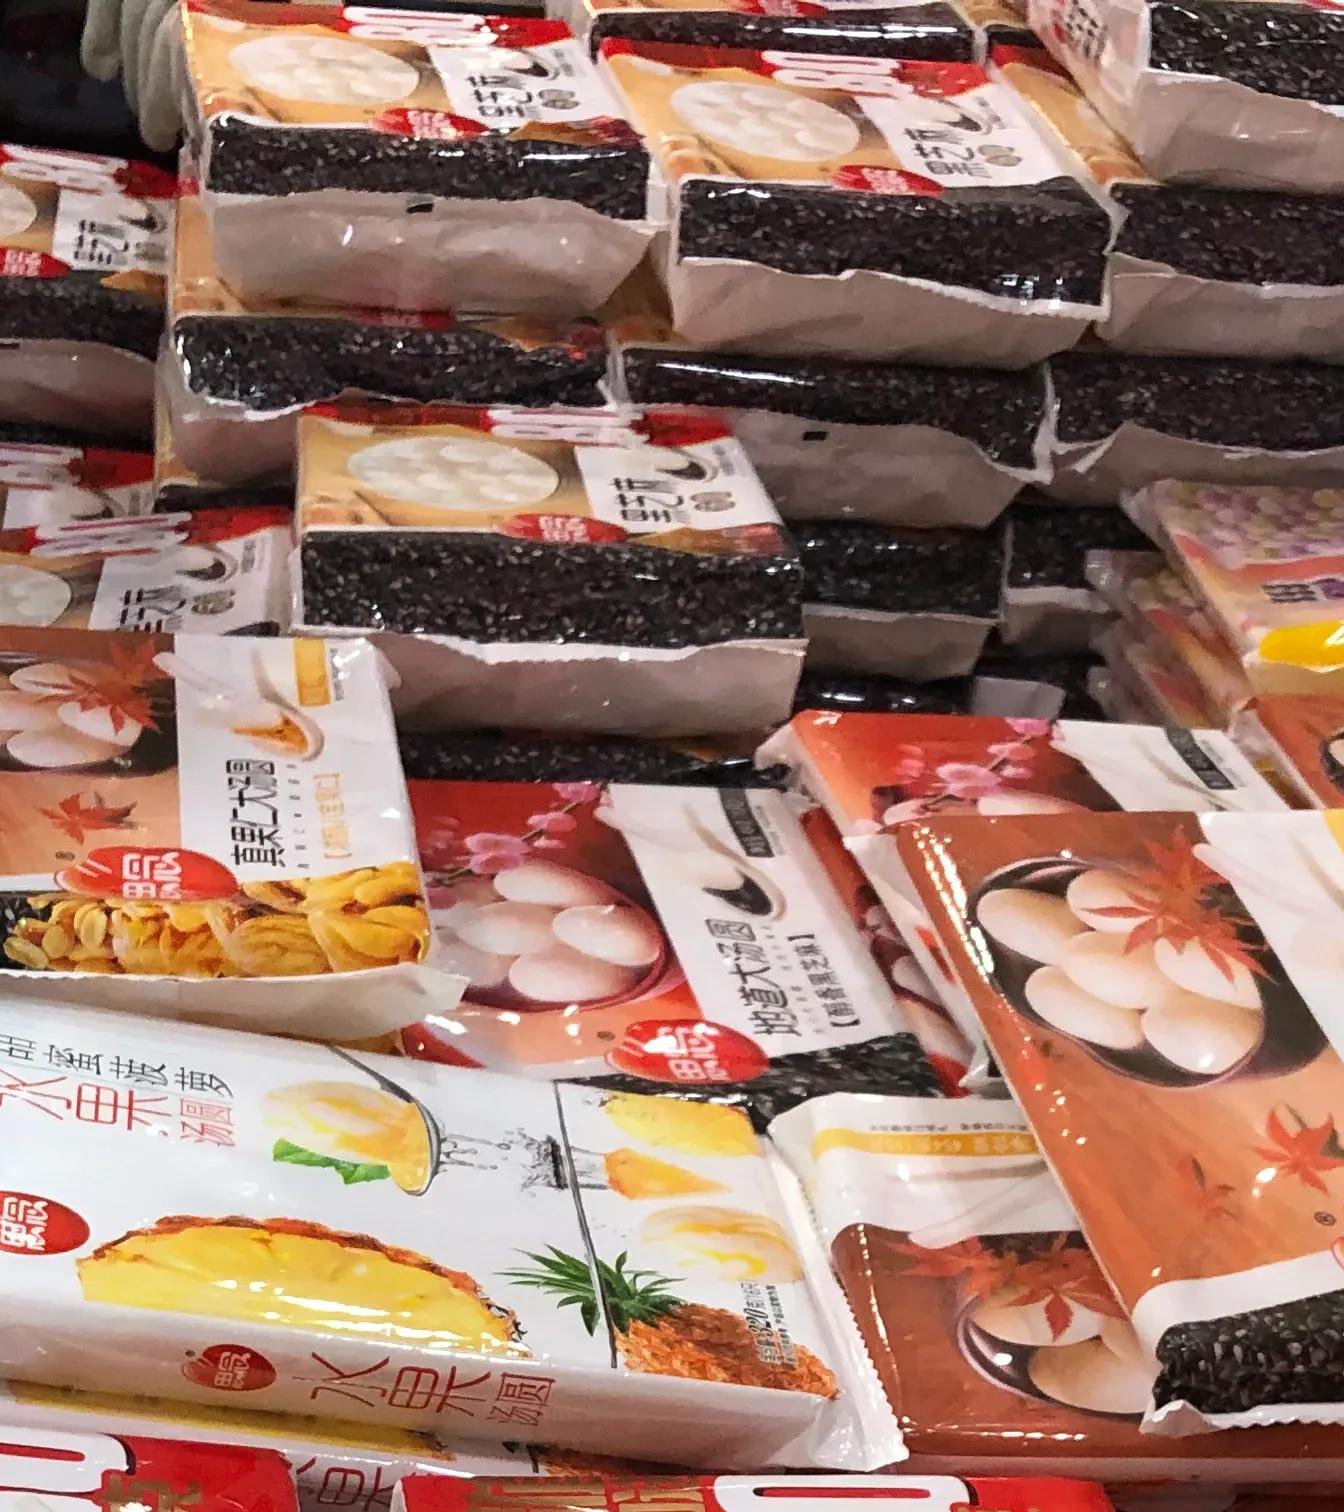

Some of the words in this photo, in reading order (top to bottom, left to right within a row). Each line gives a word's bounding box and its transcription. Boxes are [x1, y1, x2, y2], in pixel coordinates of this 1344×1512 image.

[121, 851, 183, 899] 思念
[705, 918, 802, 1037] 地道大汤圆
[0, 1196, 49, 1250] 思念
